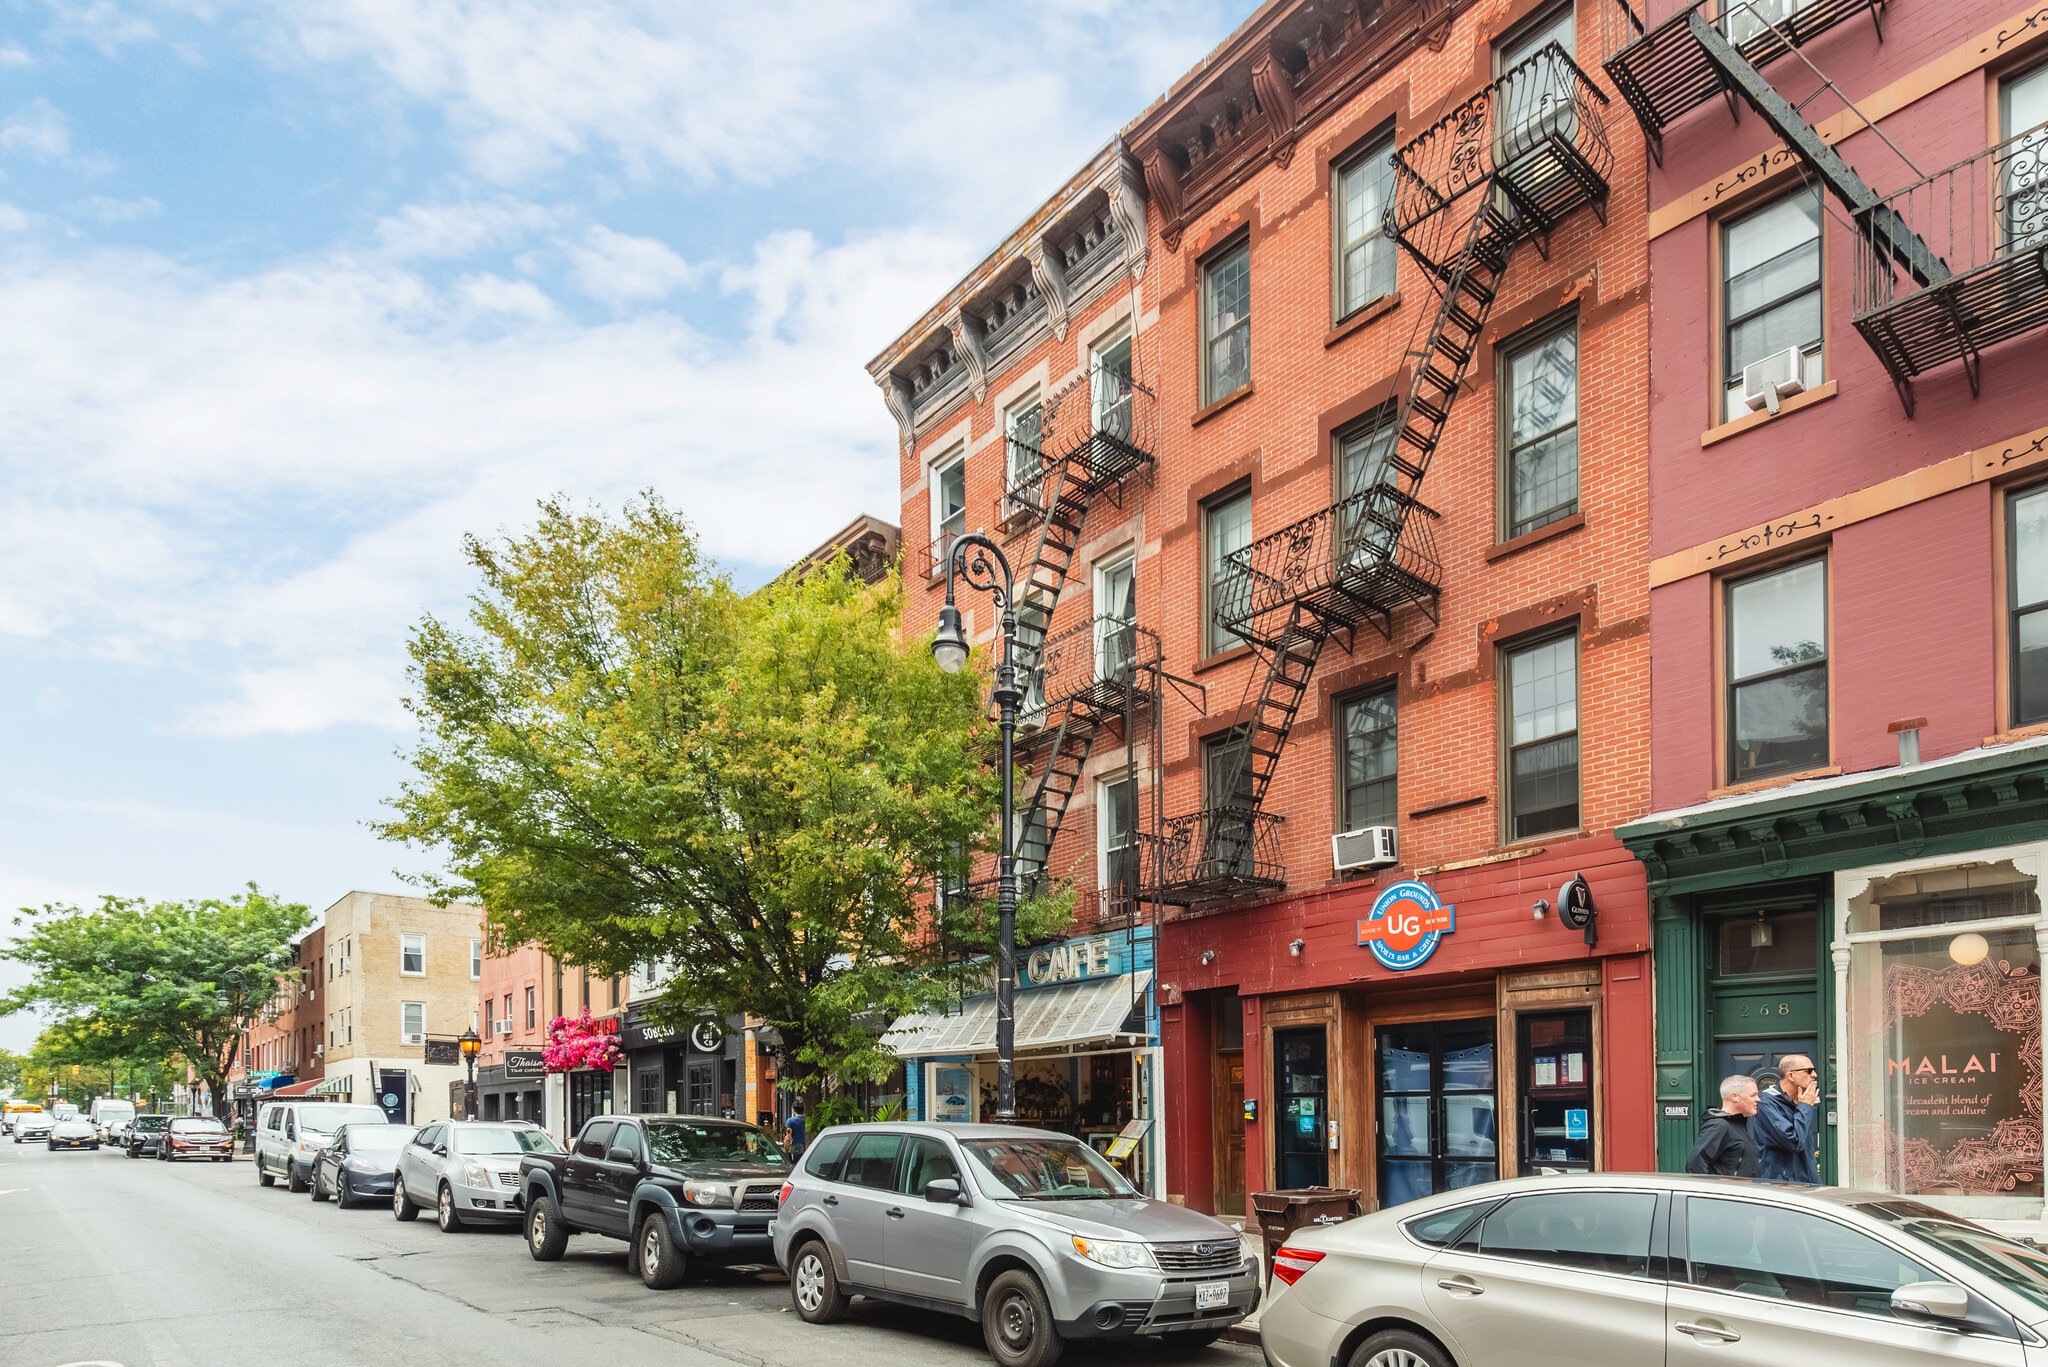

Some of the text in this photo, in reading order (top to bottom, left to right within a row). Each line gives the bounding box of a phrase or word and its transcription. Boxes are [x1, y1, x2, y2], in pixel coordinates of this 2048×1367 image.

[1377, 889, 1430, 915] UNION GROUNDS
[1387, 914, 1420, 936] UG
[1375, 940, 1395, 960] SPORTS
[1027, 938, 1110, 985] CAFE
[1740, 1003, 1789, 1017] 268
[507, 1056, 544, 1069] Thaism
[1887, 1053, 1996, 1076] MALAI
[1909, 1076, 1976, 1085] ICE CREAM
[1906, 1093, 1993, 1107] decadent blend of
[1665, 1106, 1689, 1115] CHARNEY
[1931, 1105, 1950, 1115] and
[1952, 1104, 1987, 1115] culture
